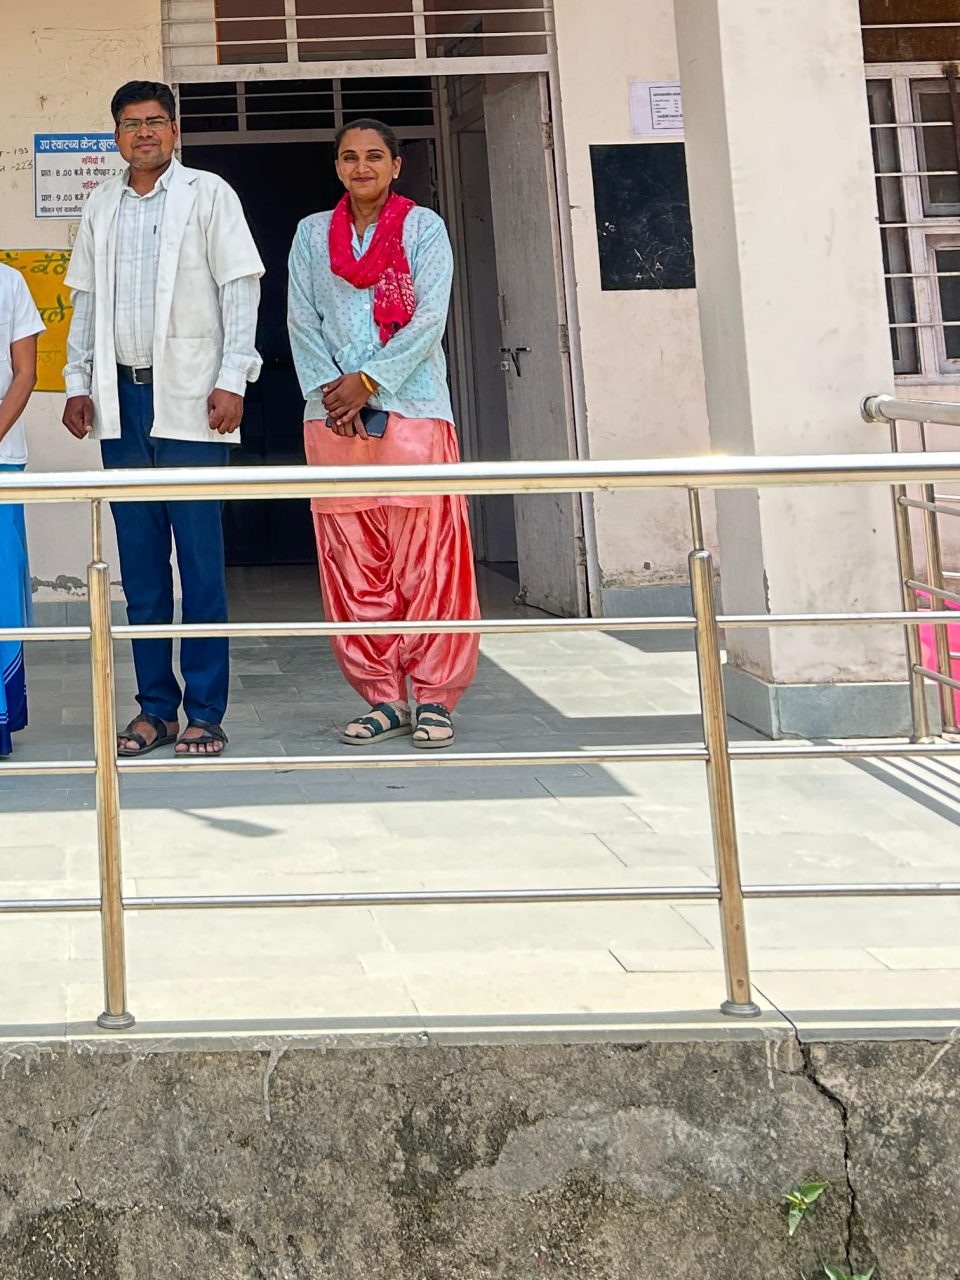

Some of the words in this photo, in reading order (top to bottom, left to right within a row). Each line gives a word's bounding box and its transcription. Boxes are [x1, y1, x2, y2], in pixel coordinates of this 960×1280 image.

[40, 140, 49, 149] उप
[51, 140, 79, 149] स्वास्थ्य
[80, 137, 97, 149] केन्द्र
